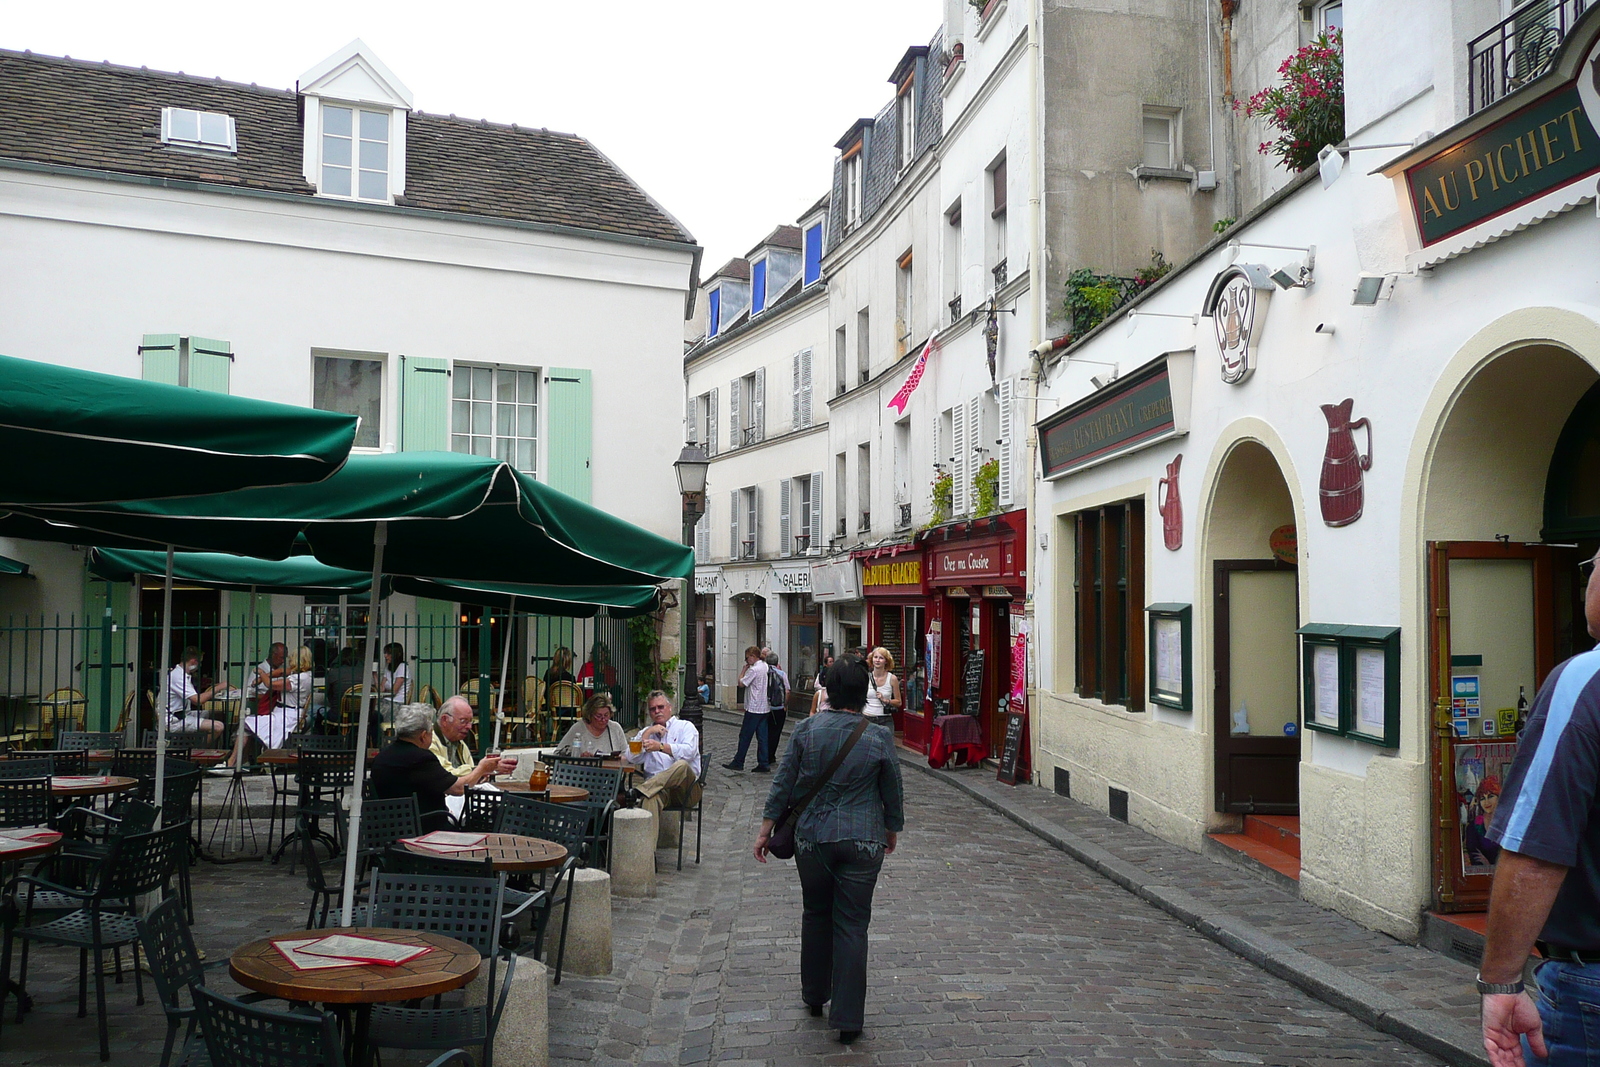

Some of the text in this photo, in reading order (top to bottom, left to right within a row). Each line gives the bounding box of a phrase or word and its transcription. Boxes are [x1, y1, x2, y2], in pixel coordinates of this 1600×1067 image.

[1423, 106, 1583, 224] AU PICHET
[1073, 402, 1135, 450] RESTAURANT
[943, 552, 990, 571] Chez ma Cousine
[871, 563, 892, 586] BUTTE
[1455, 682, 1476, 693] CB
